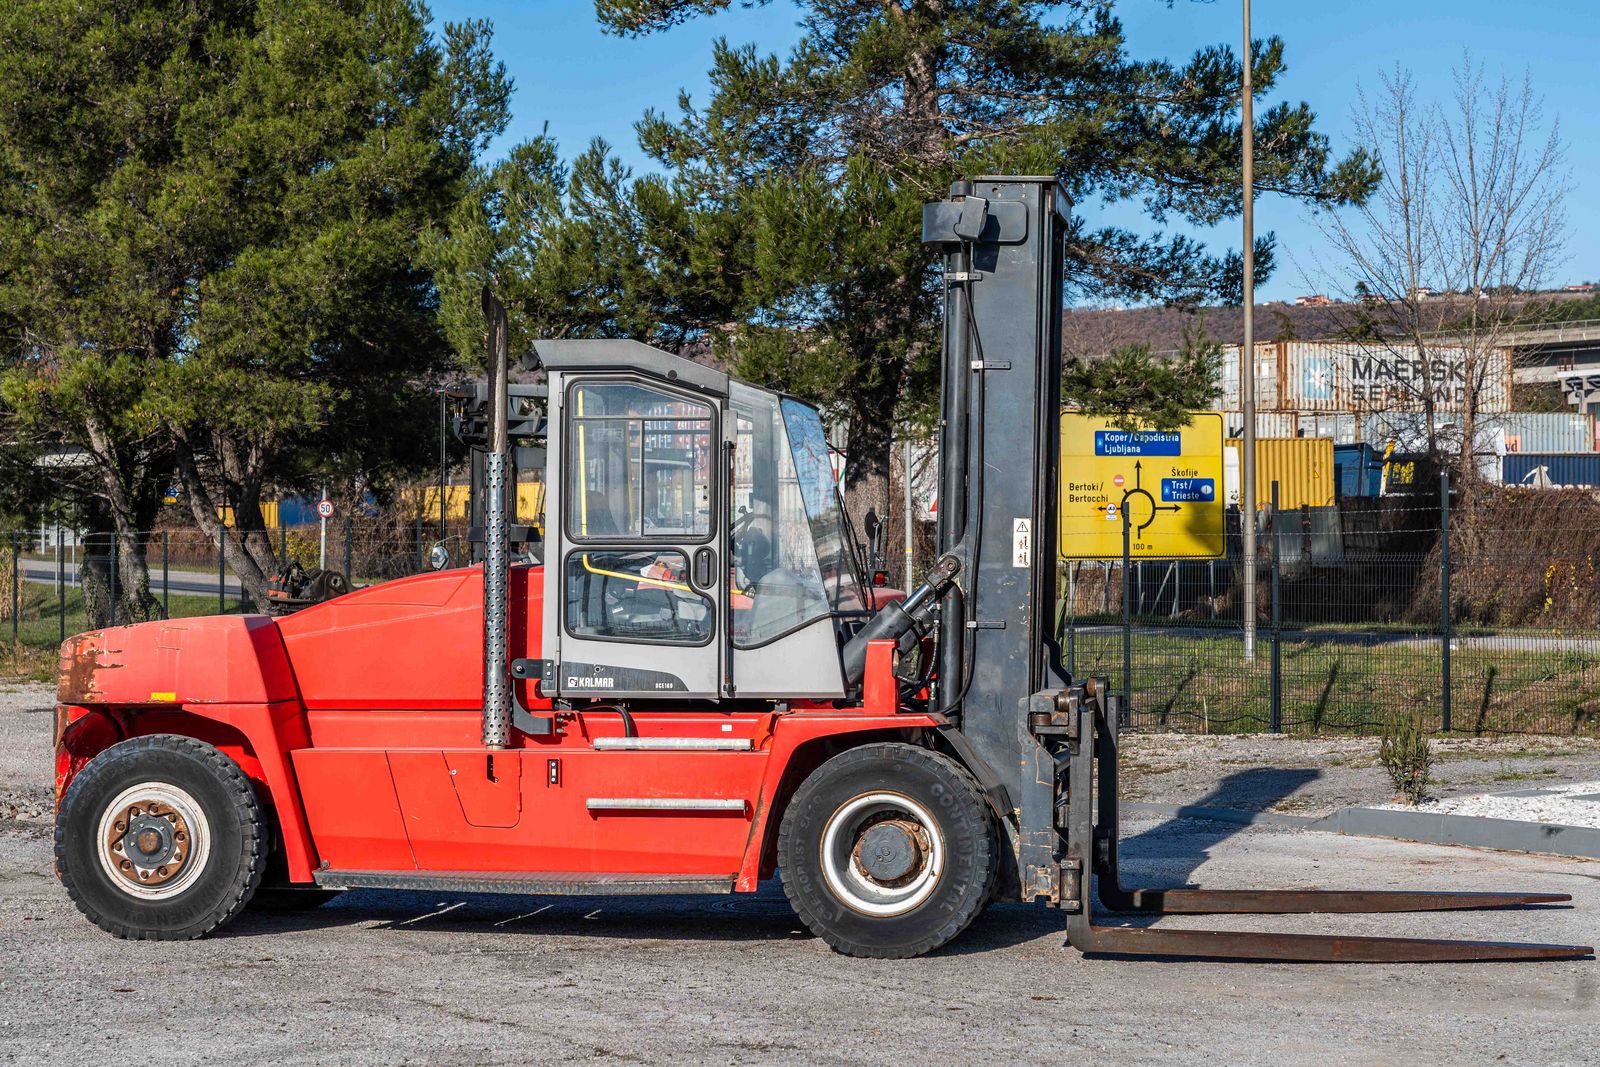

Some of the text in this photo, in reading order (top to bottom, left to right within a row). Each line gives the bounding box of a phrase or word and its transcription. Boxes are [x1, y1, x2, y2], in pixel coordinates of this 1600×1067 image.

[1352, 358, 1466, 382] MAERSK
[1352, 384, 1466, 403] SEALND
[1104, 444, 1141, 454] Ljubljana
[1171, 467, 1198, 478] Škofije
[1069, 494, 1109, 502] Bertocchi
[1171, 491, 1200, 500] Trieste
[320, 504, 331, 513] 50
[579, 677, 614, 688] KALMAR
